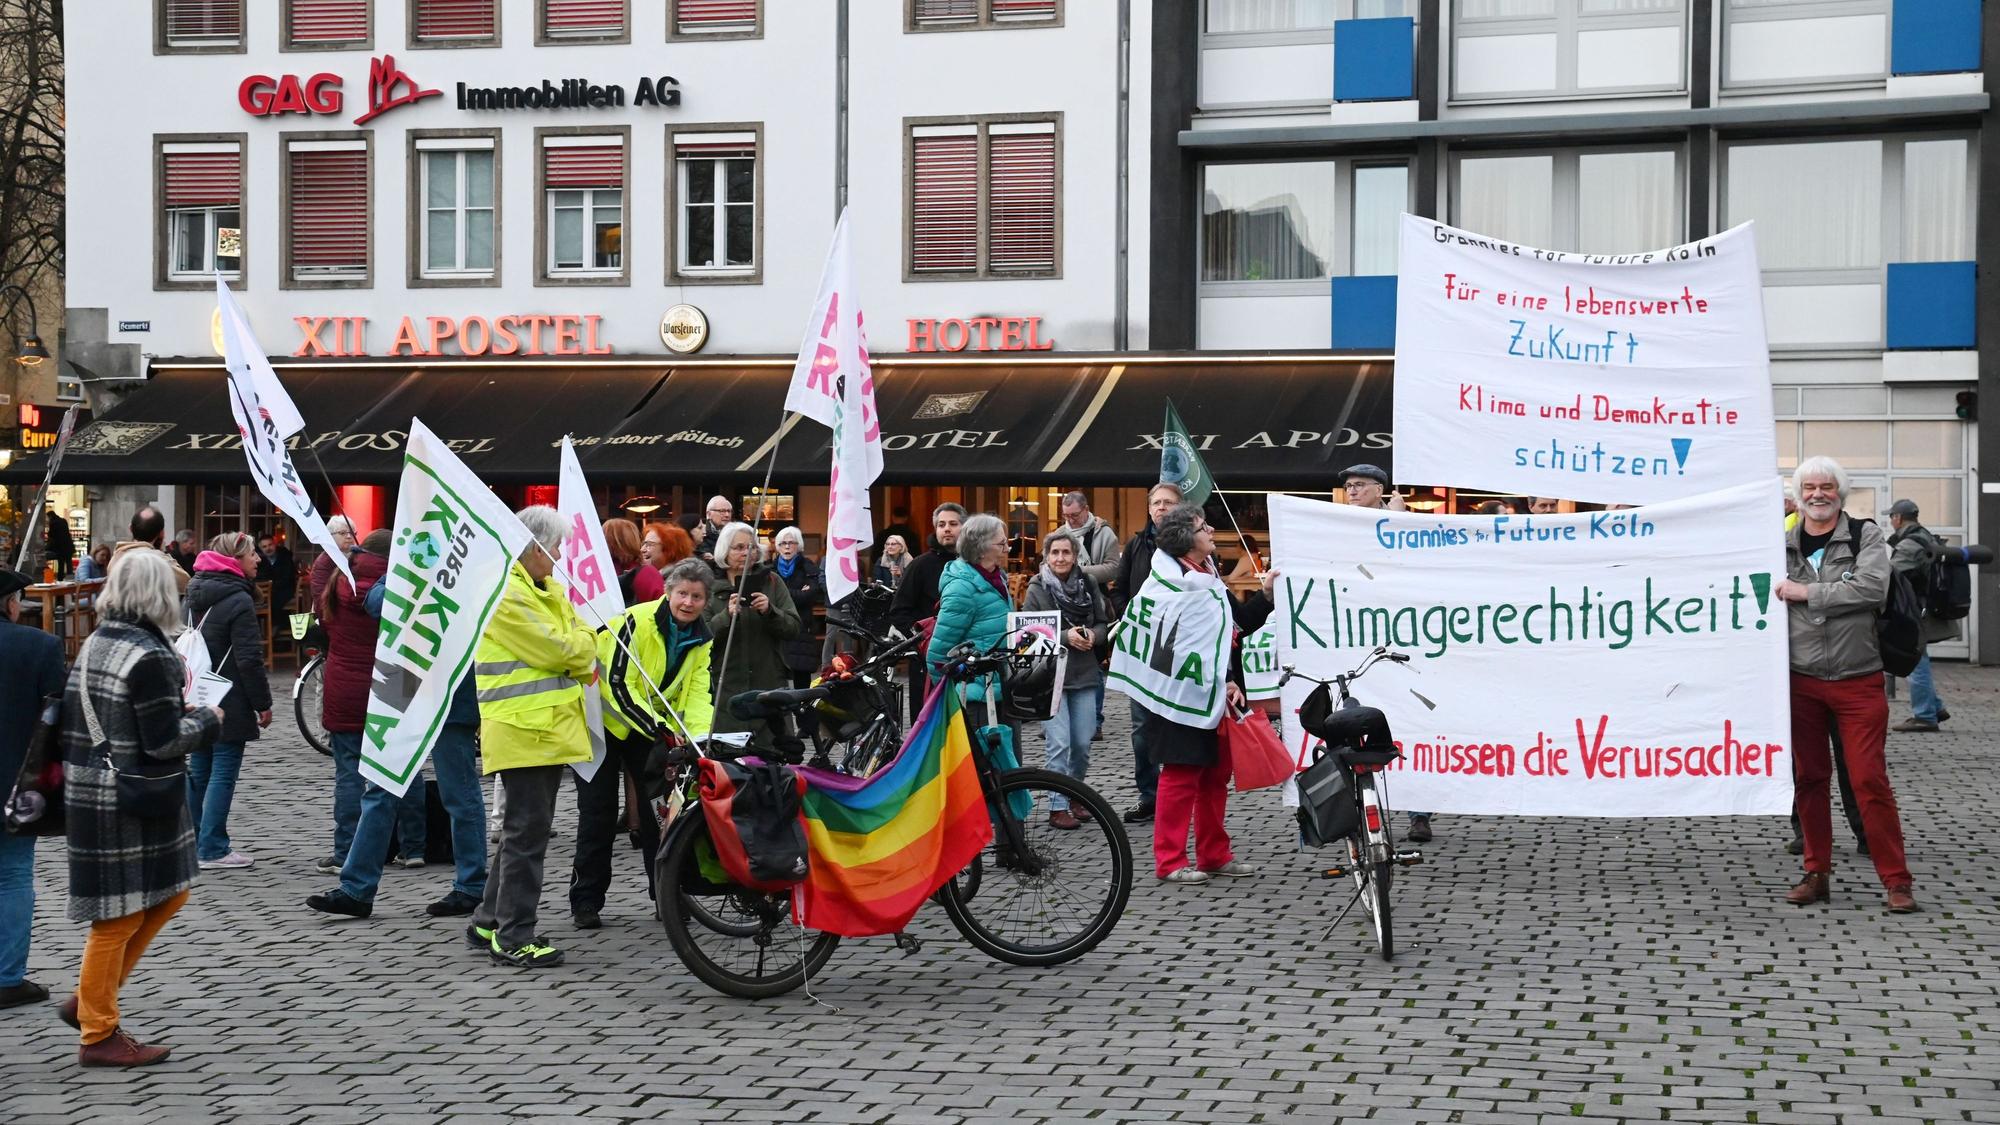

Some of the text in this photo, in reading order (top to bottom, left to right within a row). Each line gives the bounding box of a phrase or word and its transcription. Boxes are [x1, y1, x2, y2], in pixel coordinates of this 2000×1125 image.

[238, 72, 343, 117] GAG
[456, 75, 681, 110] Immobilien AG
[1434, 225, 1520, 256] Grannies
[1444, 273, 1709, 315] Für eine lebenswerte
[293, 314, 612, 357] XII APOSTEL
[663, 322, 702, 335] Warsteiner
[906, 316, 1055, 352] HOTEL
[21, 404, 39, 427] My
[1459, 383, 1738, 425] Klima und Demokratie
[279, 430, 495, 454] APOSEL
[825, 429, 1009, 451] OTEL
[1126, 427, 1393, 450] XI APOS
[1515, 438, 1692, 475] schützen!
[1376, 513, 1654, 549] Grannies for Future Köln
[1020, 616, 1055, 625] There is no
[1286, 573, 1771, 658] Klimagerechtigkeit!
[1413, 735, 1515, 777] müssen
[1523, 731, 1569, 776] die
[1575, 714, 1783, 779] Verursacher
